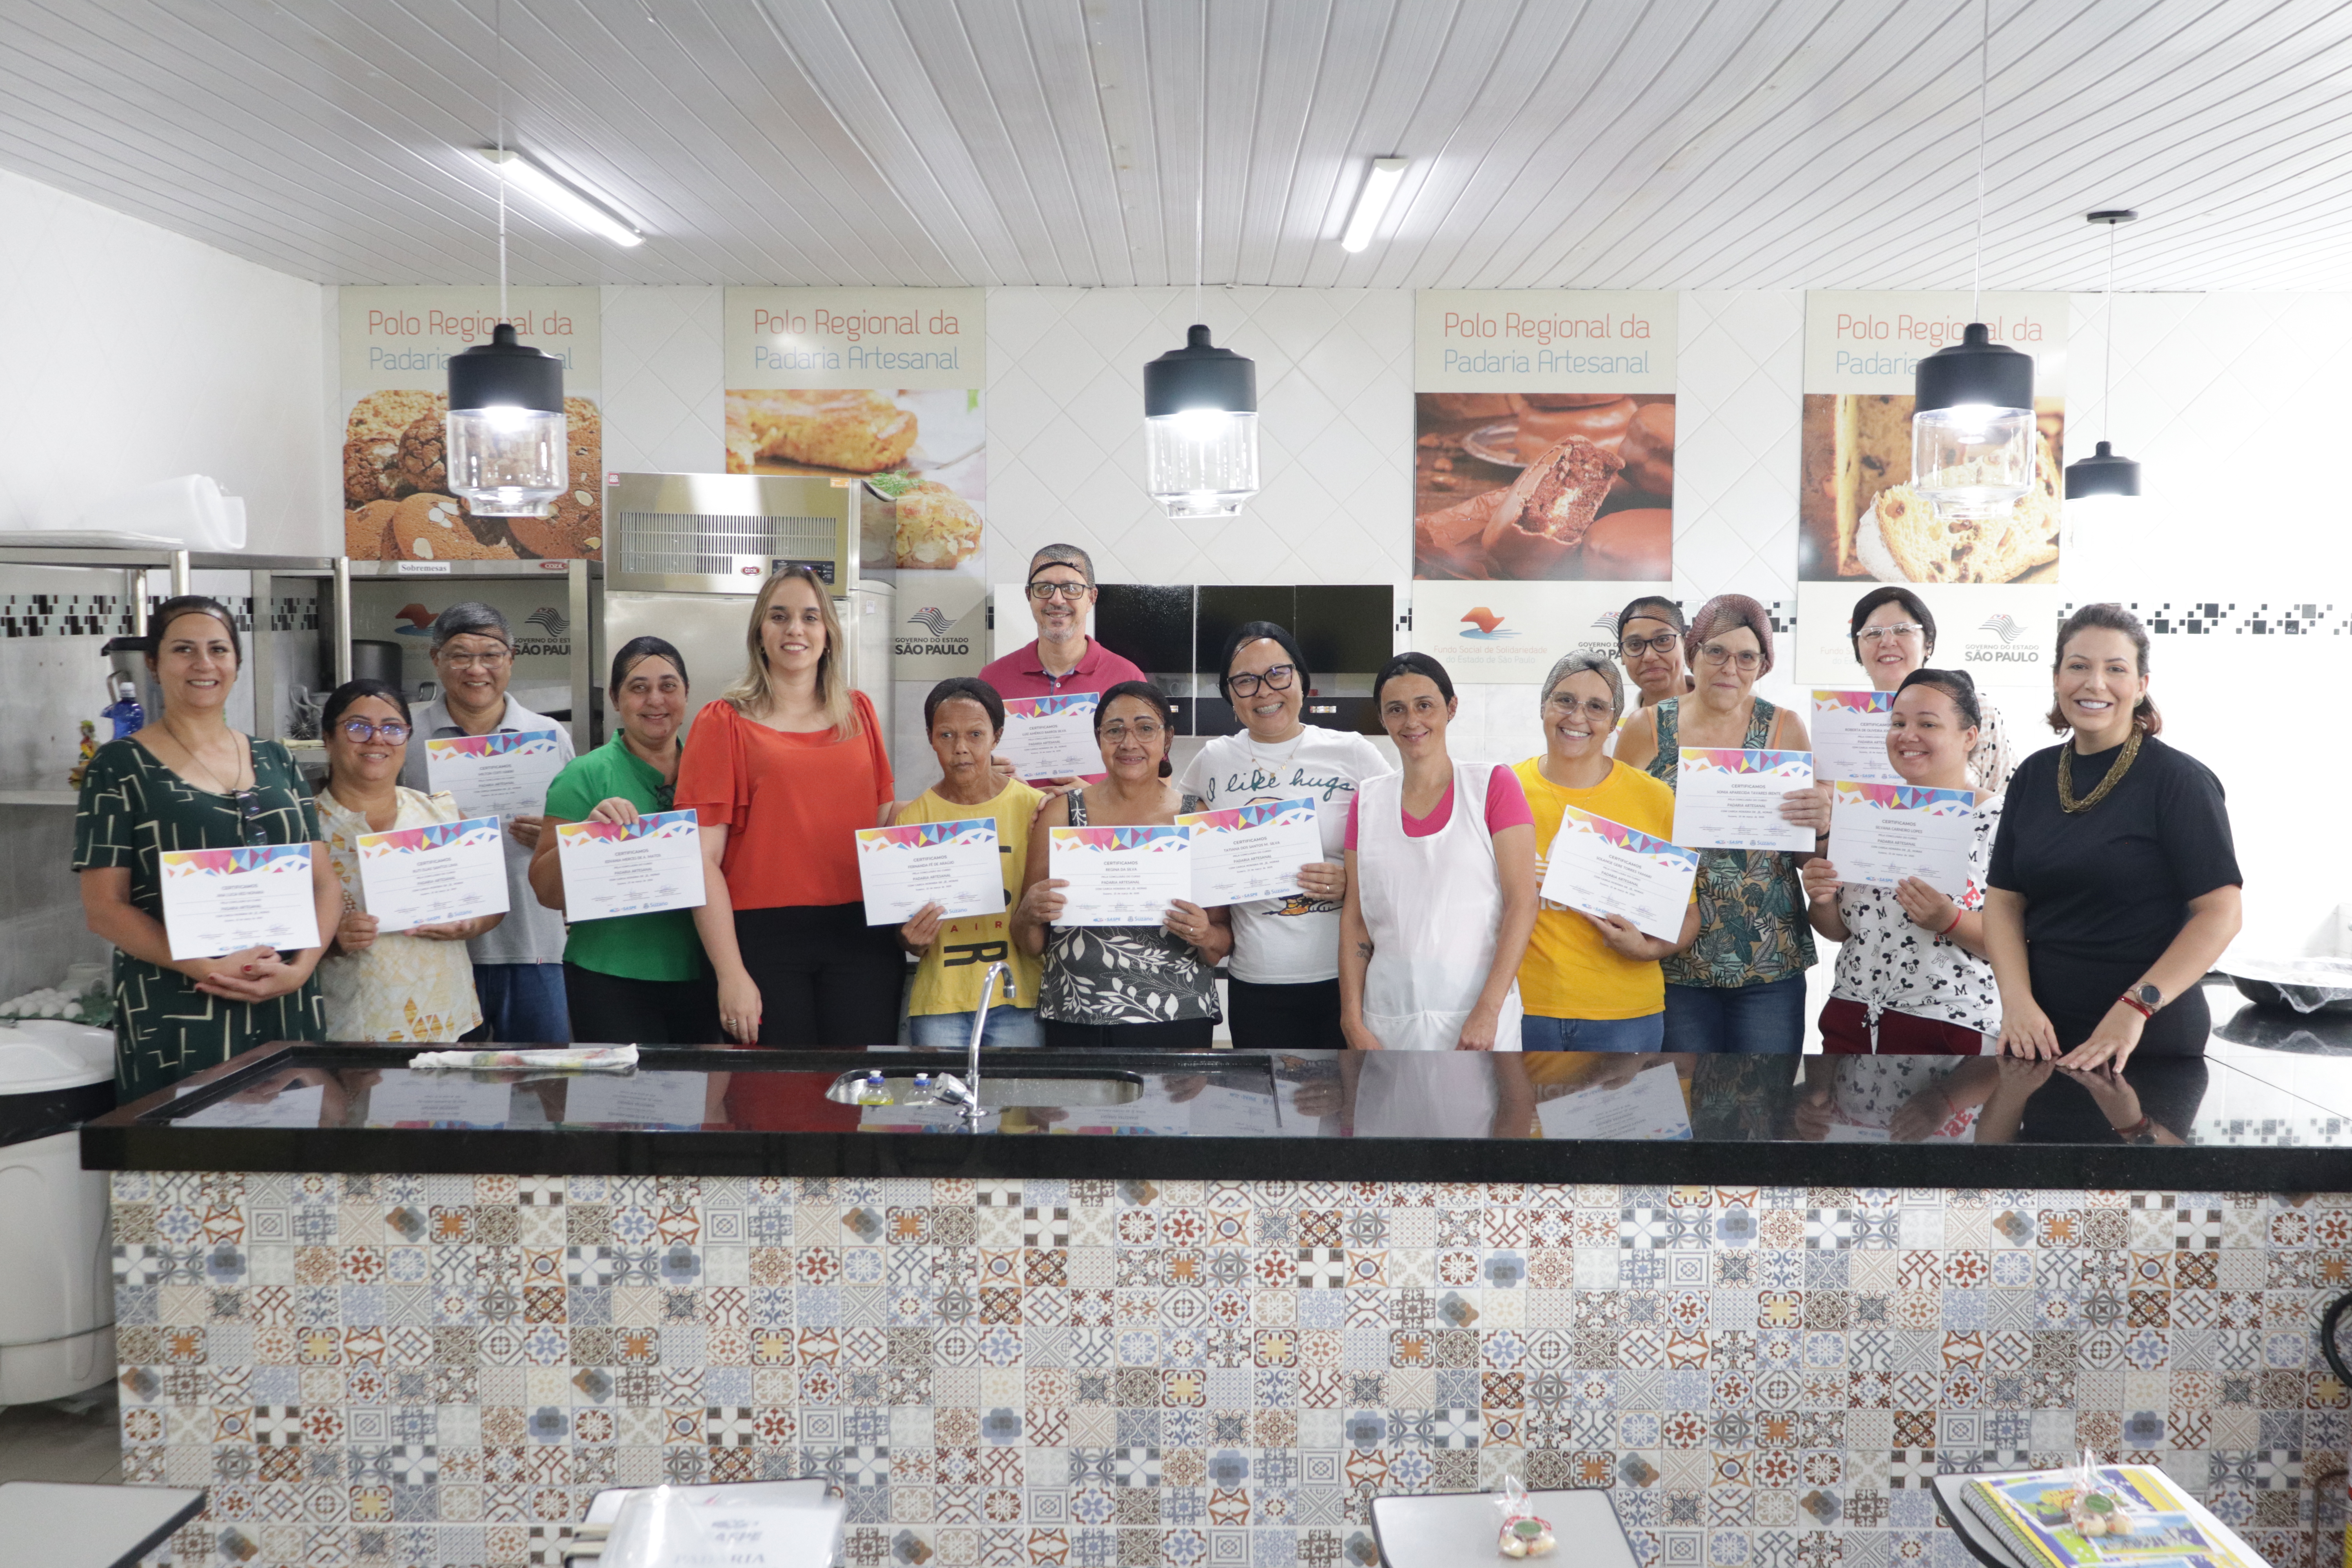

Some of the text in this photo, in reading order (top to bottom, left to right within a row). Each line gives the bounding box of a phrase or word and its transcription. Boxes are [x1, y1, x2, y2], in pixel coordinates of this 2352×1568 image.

[369, 310, 573, 342] Polo Regioal da
[755, 309, 959, 341] Polo Regional da
[1445, 312, 1650, 345] Polo Regional da
[1837, 314, 2042, 347] Polo Regioal da
[755, 346, 959, 369] Padaria Artesanal
[1445, 349, 1649, 373] Padaria Artesanal
[514, 643, 571, 655] SÃO PAU
[895, 643, 969, 655] SÃO PAULO
[1965, 650, 2038, 662] SÃO PAULO
[1225, 769, 1280, 792] like
[1289, 768, 1355, 802] hugs
[1233, 837, 1267, 845] CERTIFICAMOS
[417, 857, 451, 866] CERTIFICAMOS
[1608, 854, 1642, 869] CERTIFICAMOS
